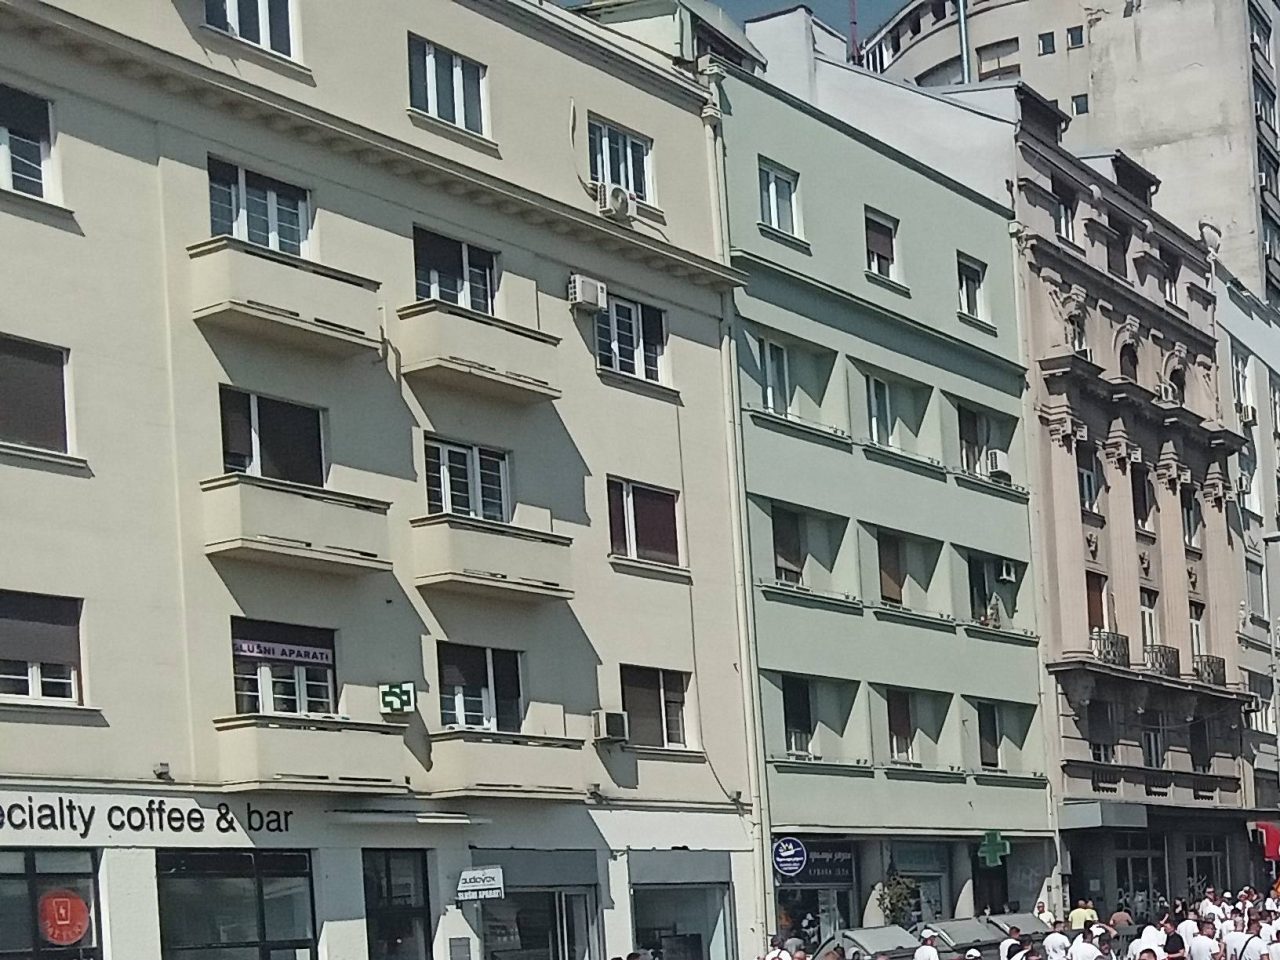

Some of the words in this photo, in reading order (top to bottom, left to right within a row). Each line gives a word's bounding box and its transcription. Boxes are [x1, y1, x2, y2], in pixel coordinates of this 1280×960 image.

[281, 648, 329, 661] APARATI
[107, 800, 204, 832] coffee
[216, 802, 237, 833] &
[247, 803, 293, 833] bar
